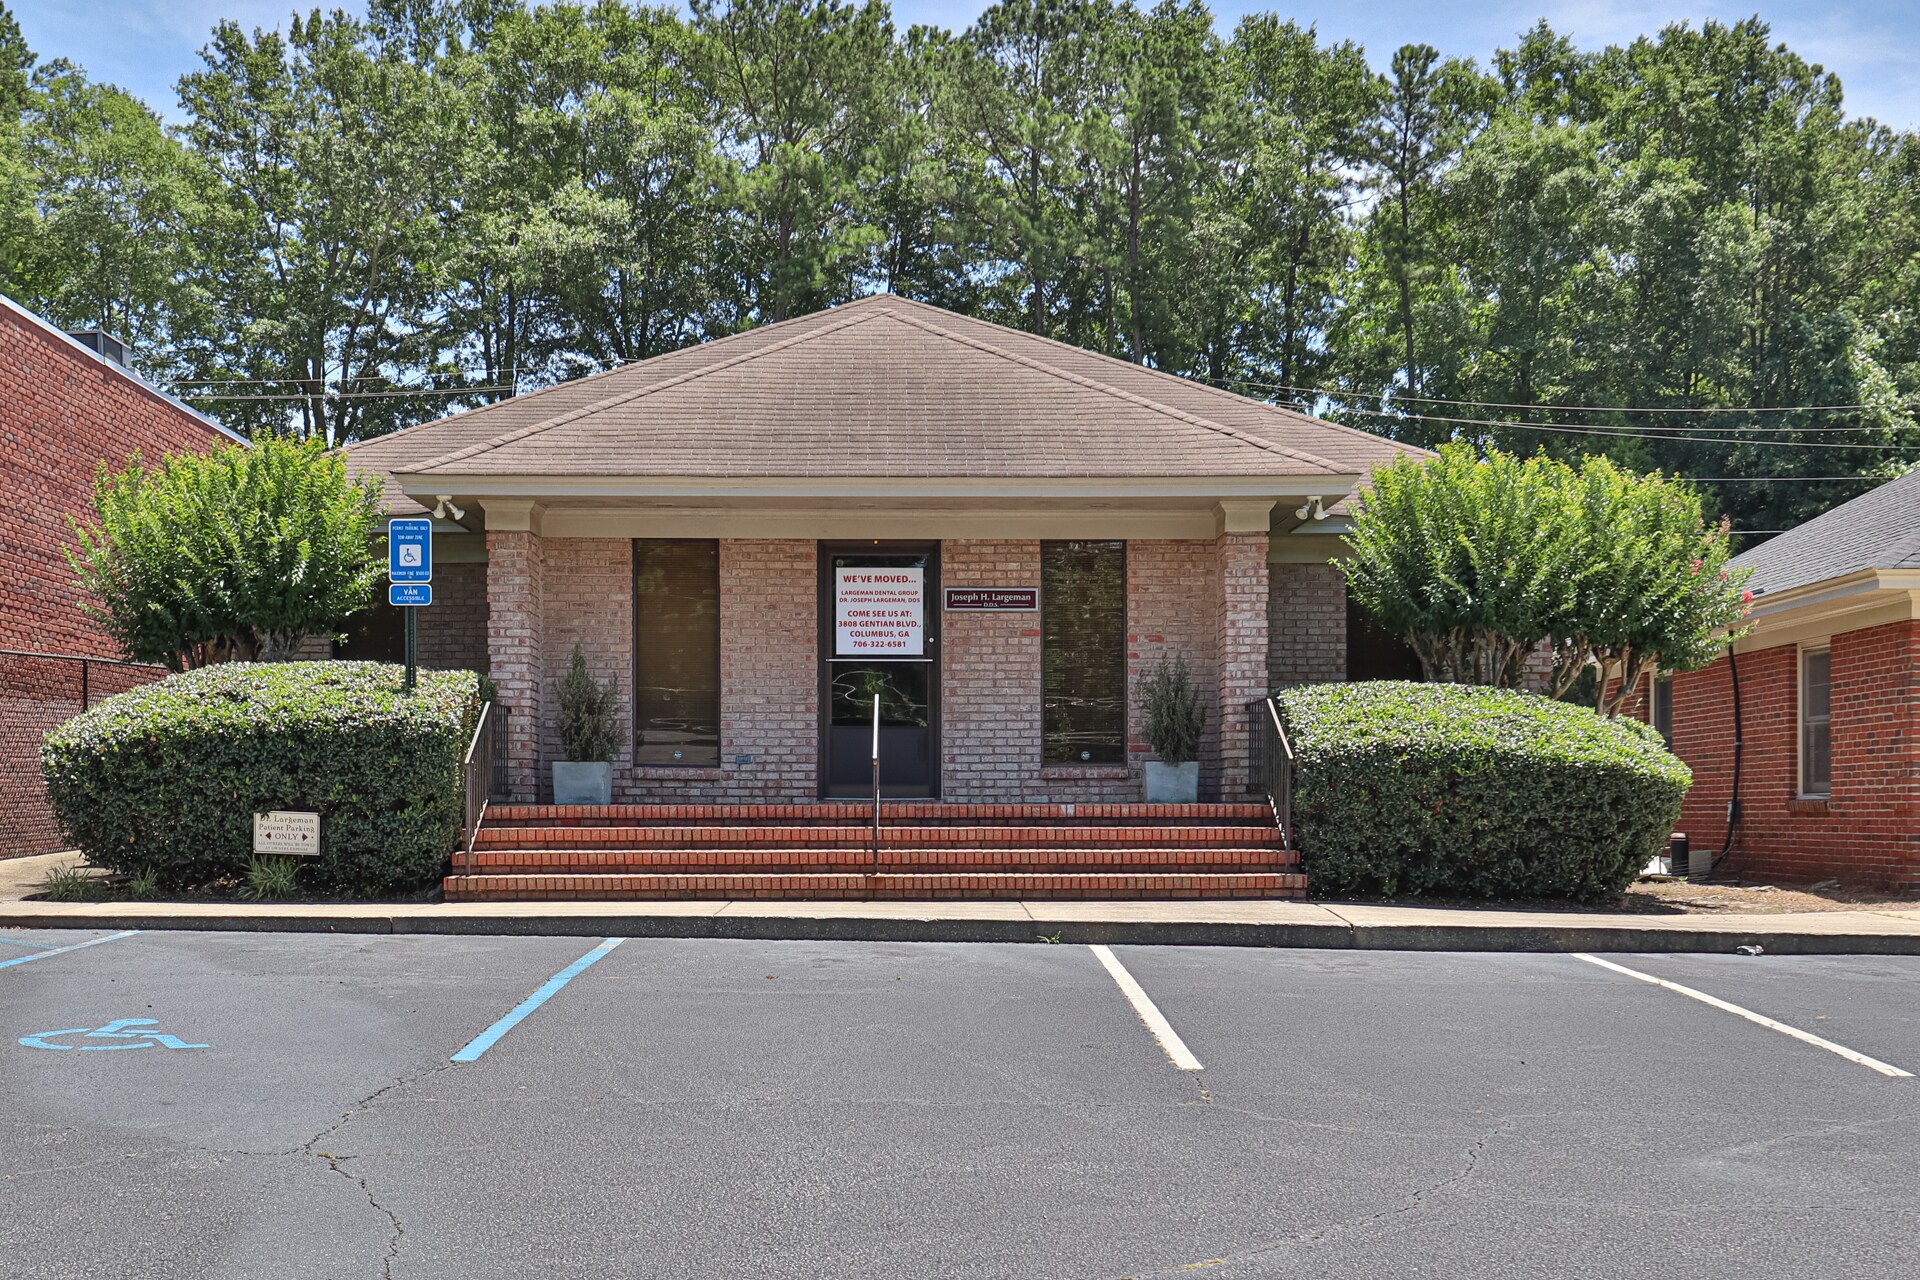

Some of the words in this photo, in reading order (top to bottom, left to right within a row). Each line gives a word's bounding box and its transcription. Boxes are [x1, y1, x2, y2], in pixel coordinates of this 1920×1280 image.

[843, 575, 872, 583] WE'VE
[874, 575, 917, 583] MOVED...
[951, 593, 978, 602] Joseph
[992, 594, 1031, 602] Largeman
[838, 620, 858, 628] 3808
[859, 620, 894, 628] GENTIAN
[896, 620, 921, 628] BLVD.,
[274, 815, 314, 824] Largeman
[286, 824, 315, 833] Parking
